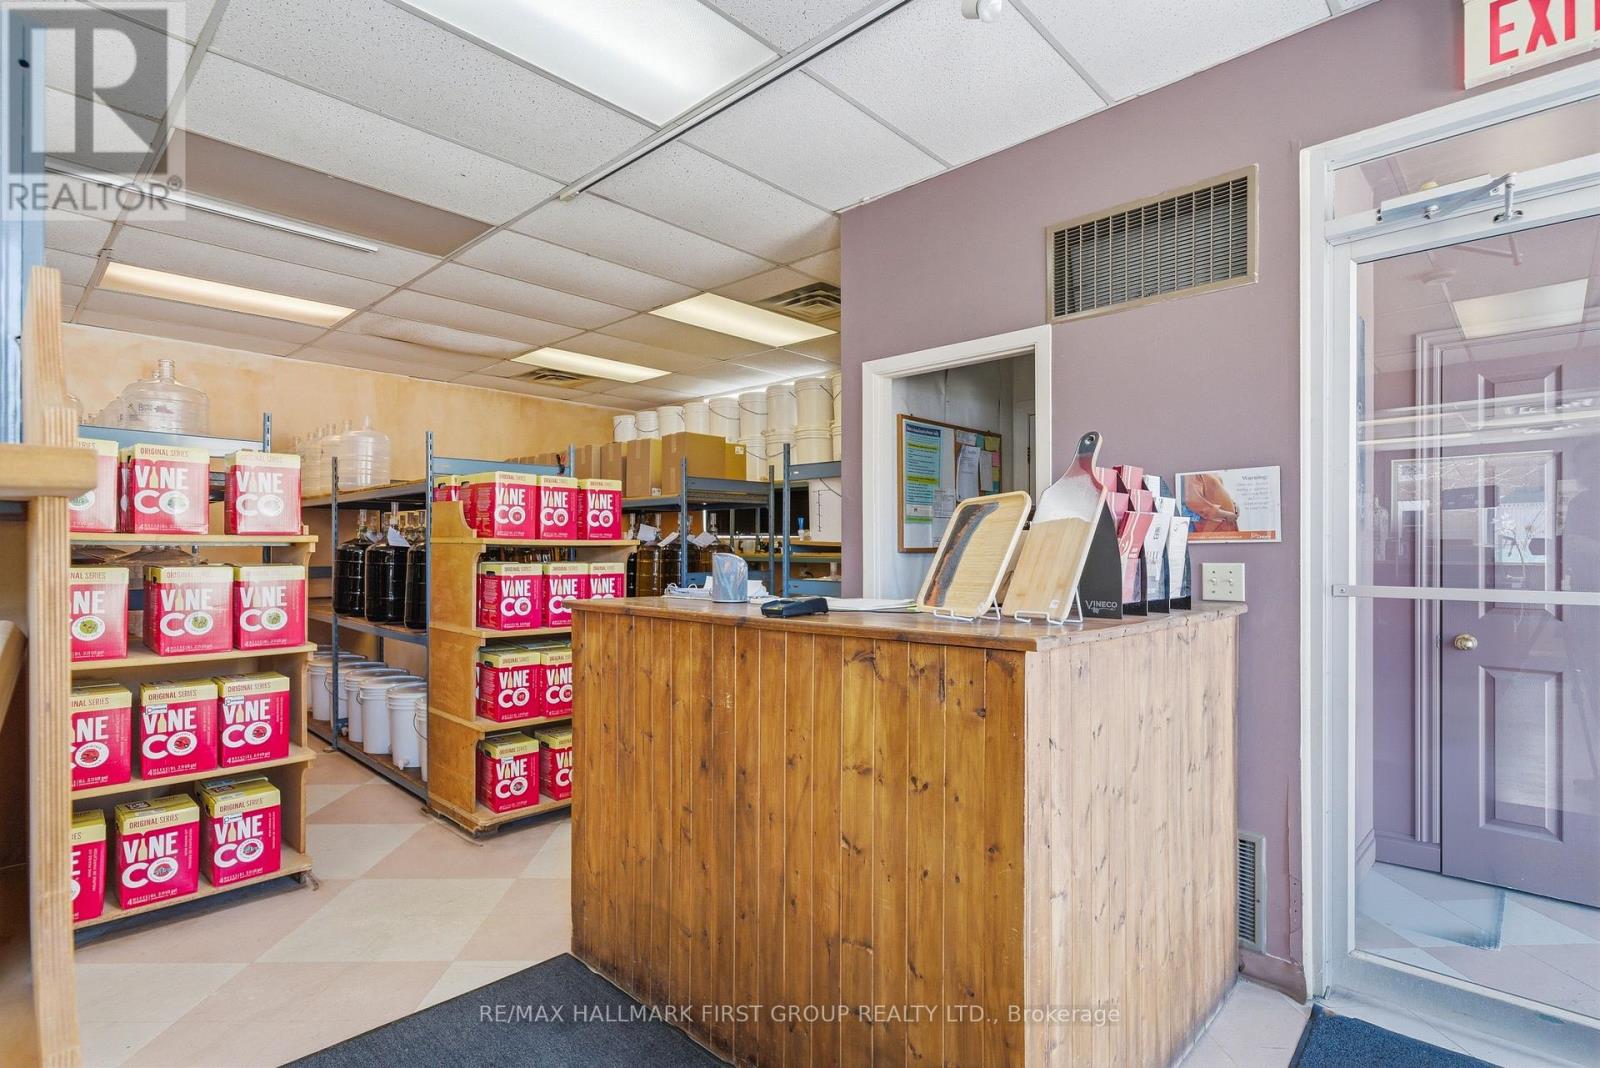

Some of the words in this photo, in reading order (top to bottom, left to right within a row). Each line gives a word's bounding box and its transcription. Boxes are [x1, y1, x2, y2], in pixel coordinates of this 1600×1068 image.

[135, 465, 189, 490] VINE
[236, 470, 283, 493] VINE
[134, 490, 189, 514] CO
[236, 493, 284, 516] CO
[496, 487, 526, 505] VINE
[541, 490, 568, 508] VINE
[588, 492, 613, 510] VINE
[494, 505, 526, 525] CO
[540, 507, 568, 527] CO
[587, 509, 613, 528] CO
[240, 586, 287, 608] VINE
[501, 579, 531, 597] VINE
[549, 578, 578, 595] VINE
[590, 577, 615, 594] VINE
[73, 591, 105, 614] NE
[160, 588, 213, 611] VINE
[500, 596, 532, 617] CO
[1085, 600, 1118, 609] VINECO
[72, 615, 105, 641] O
[160, 612, 213, 637] CO
[240, 608, 288, 632] CO
[499, 669, 529, 689] VINE
[498, 687, 530, 708] CO
[546, 684, 572, 704] CO
[143, 707, 197, 735] VINE
[223, 698, 271, 724] VINE
[76, 716, 109, 742] NE
[222, 721, 272, 748] CO
[74, 742, 109, 768] O
[142, 731, 197, 759] CO
[496, 758, 528, 780] VINE
[555, 768, 572, 787] C
[495, 777, 528, 799] CO
[214, 814, 263, 844] VINE
[123, 831, 178, 864] VINE
[214, 838, 264, 868] CO
[121, 856, 179, 888] CO
